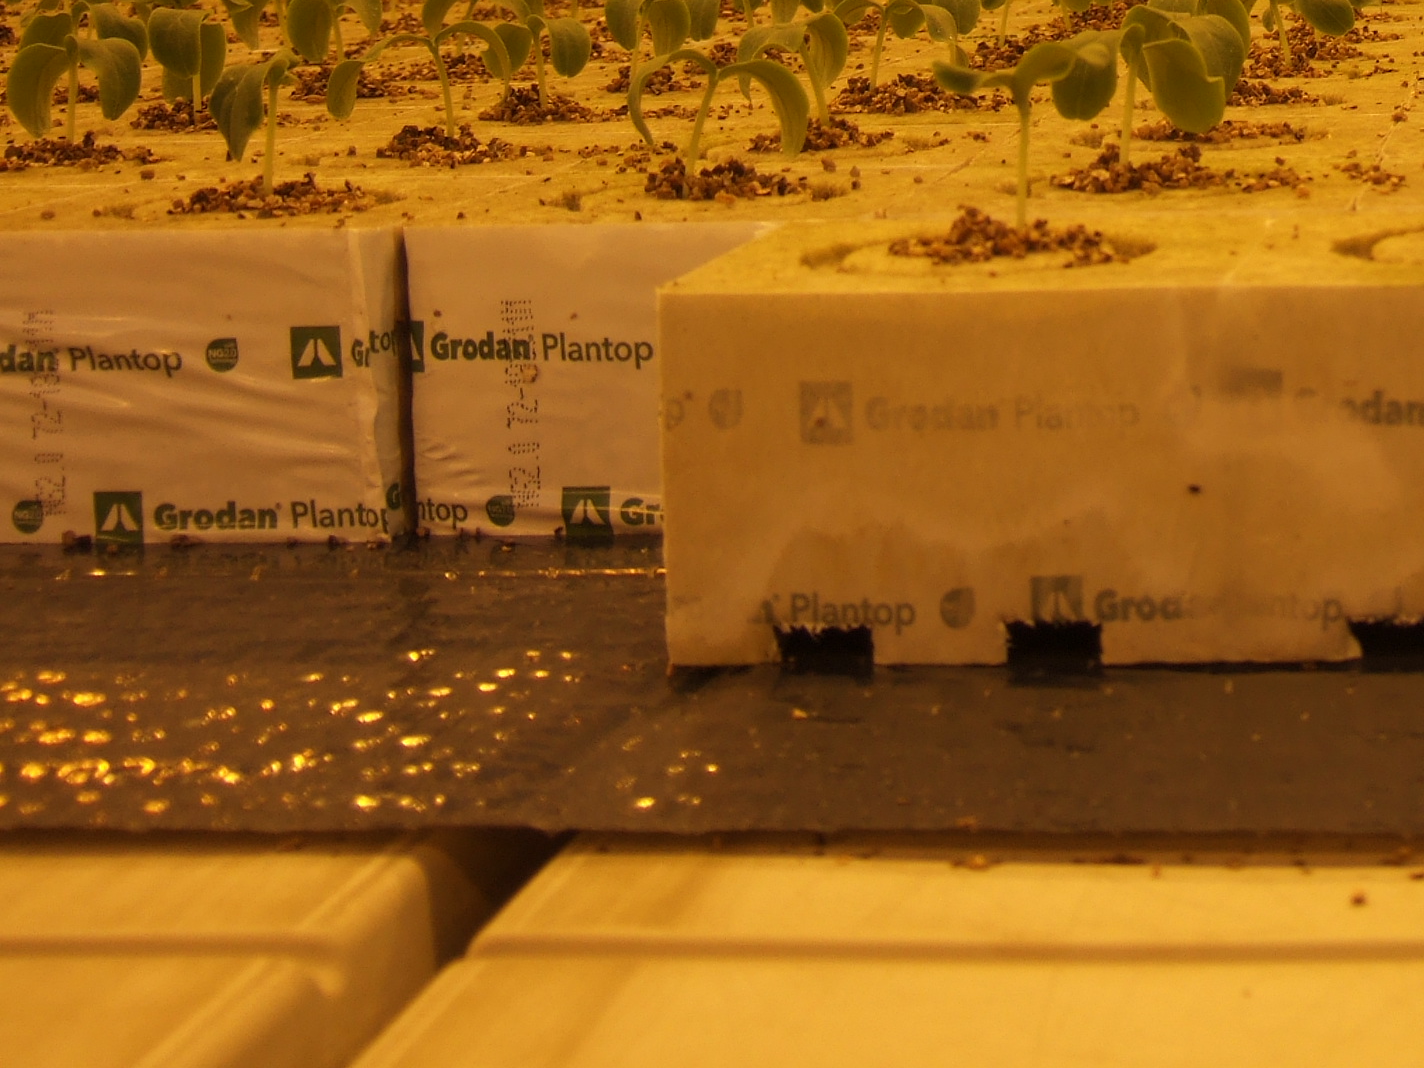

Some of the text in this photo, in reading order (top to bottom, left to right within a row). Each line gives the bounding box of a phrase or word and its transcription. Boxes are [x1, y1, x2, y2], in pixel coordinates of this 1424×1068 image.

[67, 345, 183, 378] Plantop
[542, 332, 654, 370] Plantop
[153, 500, 281, 531] Grodan
[790, 591, 917, 636] Plantop
